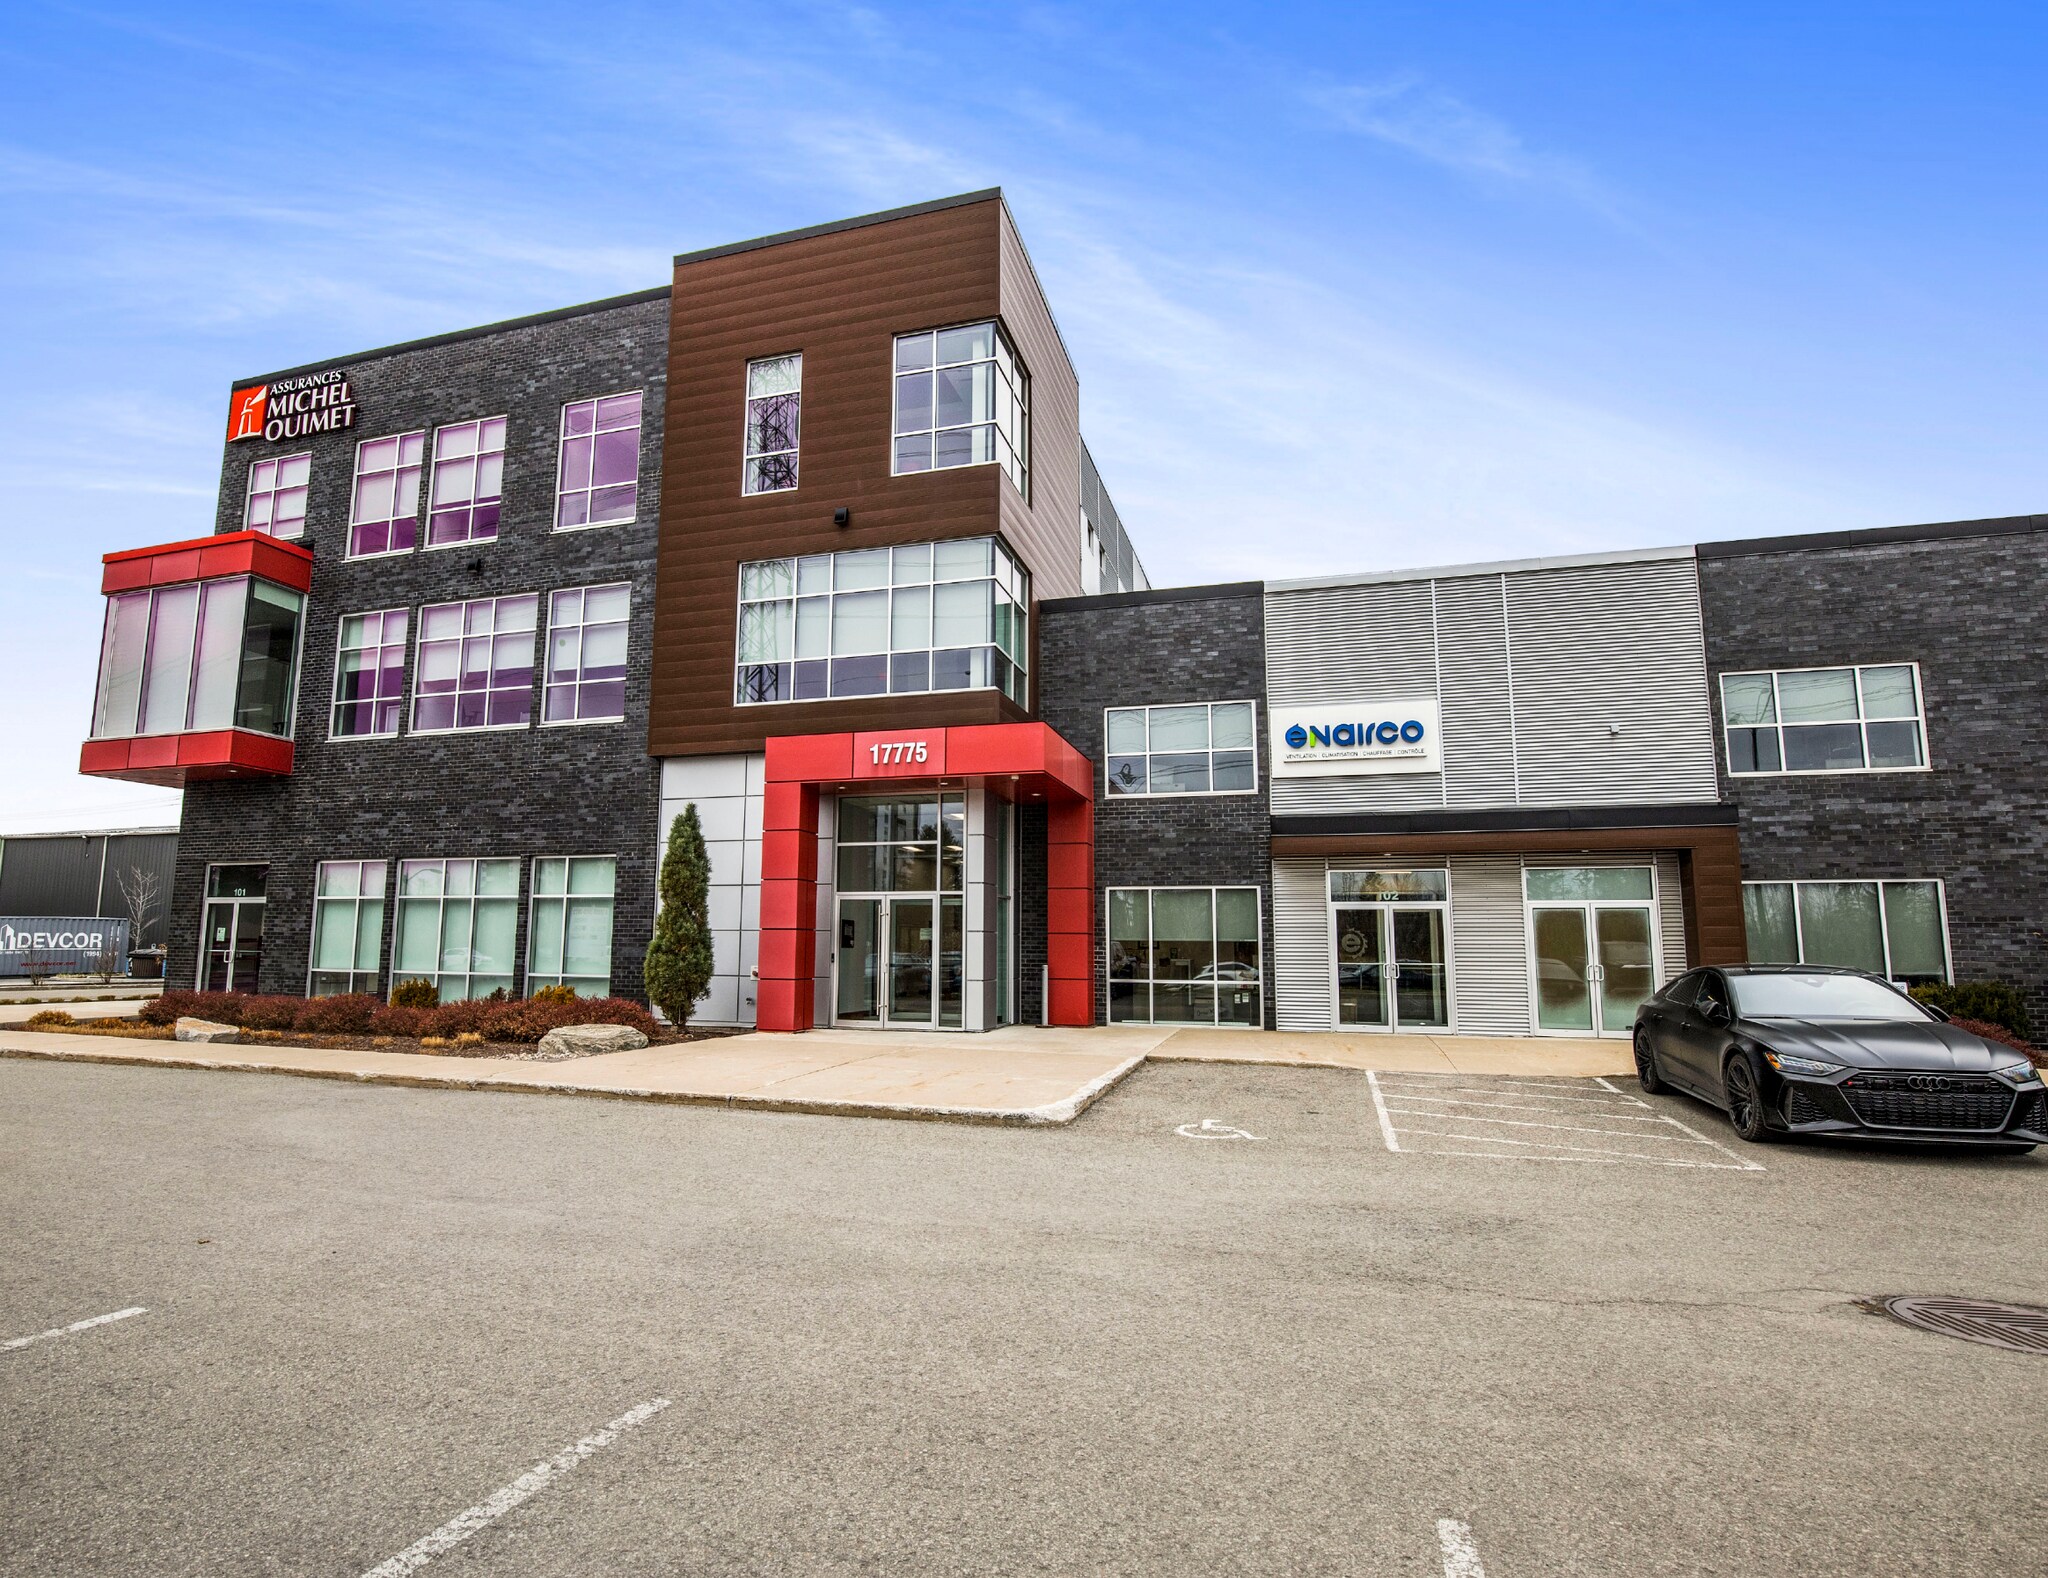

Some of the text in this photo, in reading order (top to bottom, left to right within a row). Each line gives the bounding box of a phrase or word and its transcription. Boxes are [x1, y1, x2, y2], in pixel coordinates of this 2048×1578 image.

[270, 370, 342, 396] ASSURANCES
[267, 382, 351, 419] MICHEL
[265, 404, 356, 442] OUIMET
[869, 741, 928, 765] 17775
[1397, 747, 1425, 755] CONTRÔLE
[233, 888, 247, 897] 101
[1378, 891, 1400, 901] 102
[17, 932, 103, 949] DEVCOR
